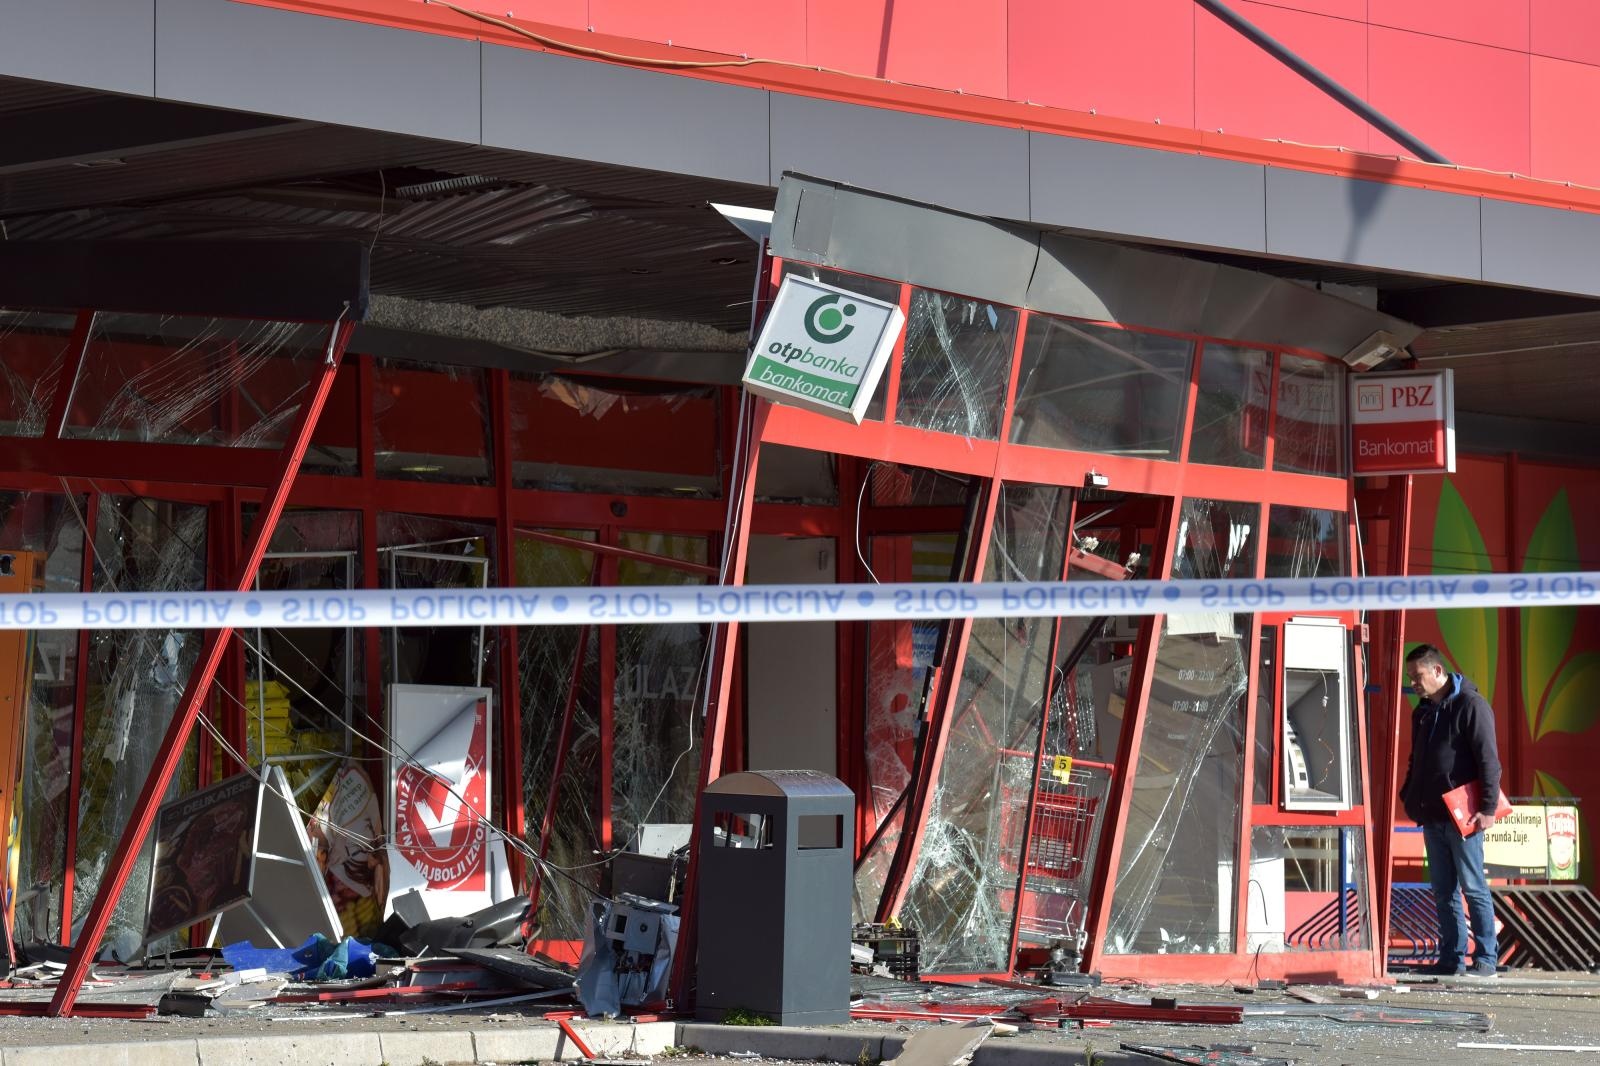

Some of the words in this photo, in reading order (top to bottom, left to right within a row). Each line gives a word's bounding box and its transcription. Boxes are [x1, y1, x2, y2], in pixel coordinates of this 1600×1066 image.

[760, 365, 848, 405] bankomat
[1391, 385, 1434, 408] PBZ
[1359, 438, 1435, 456] Bankomat
[1059, 759, 1067, 770] 5
[1491, 831, 1512, 842] runda
[415, 858, 466, 882] NAJBOLJI
